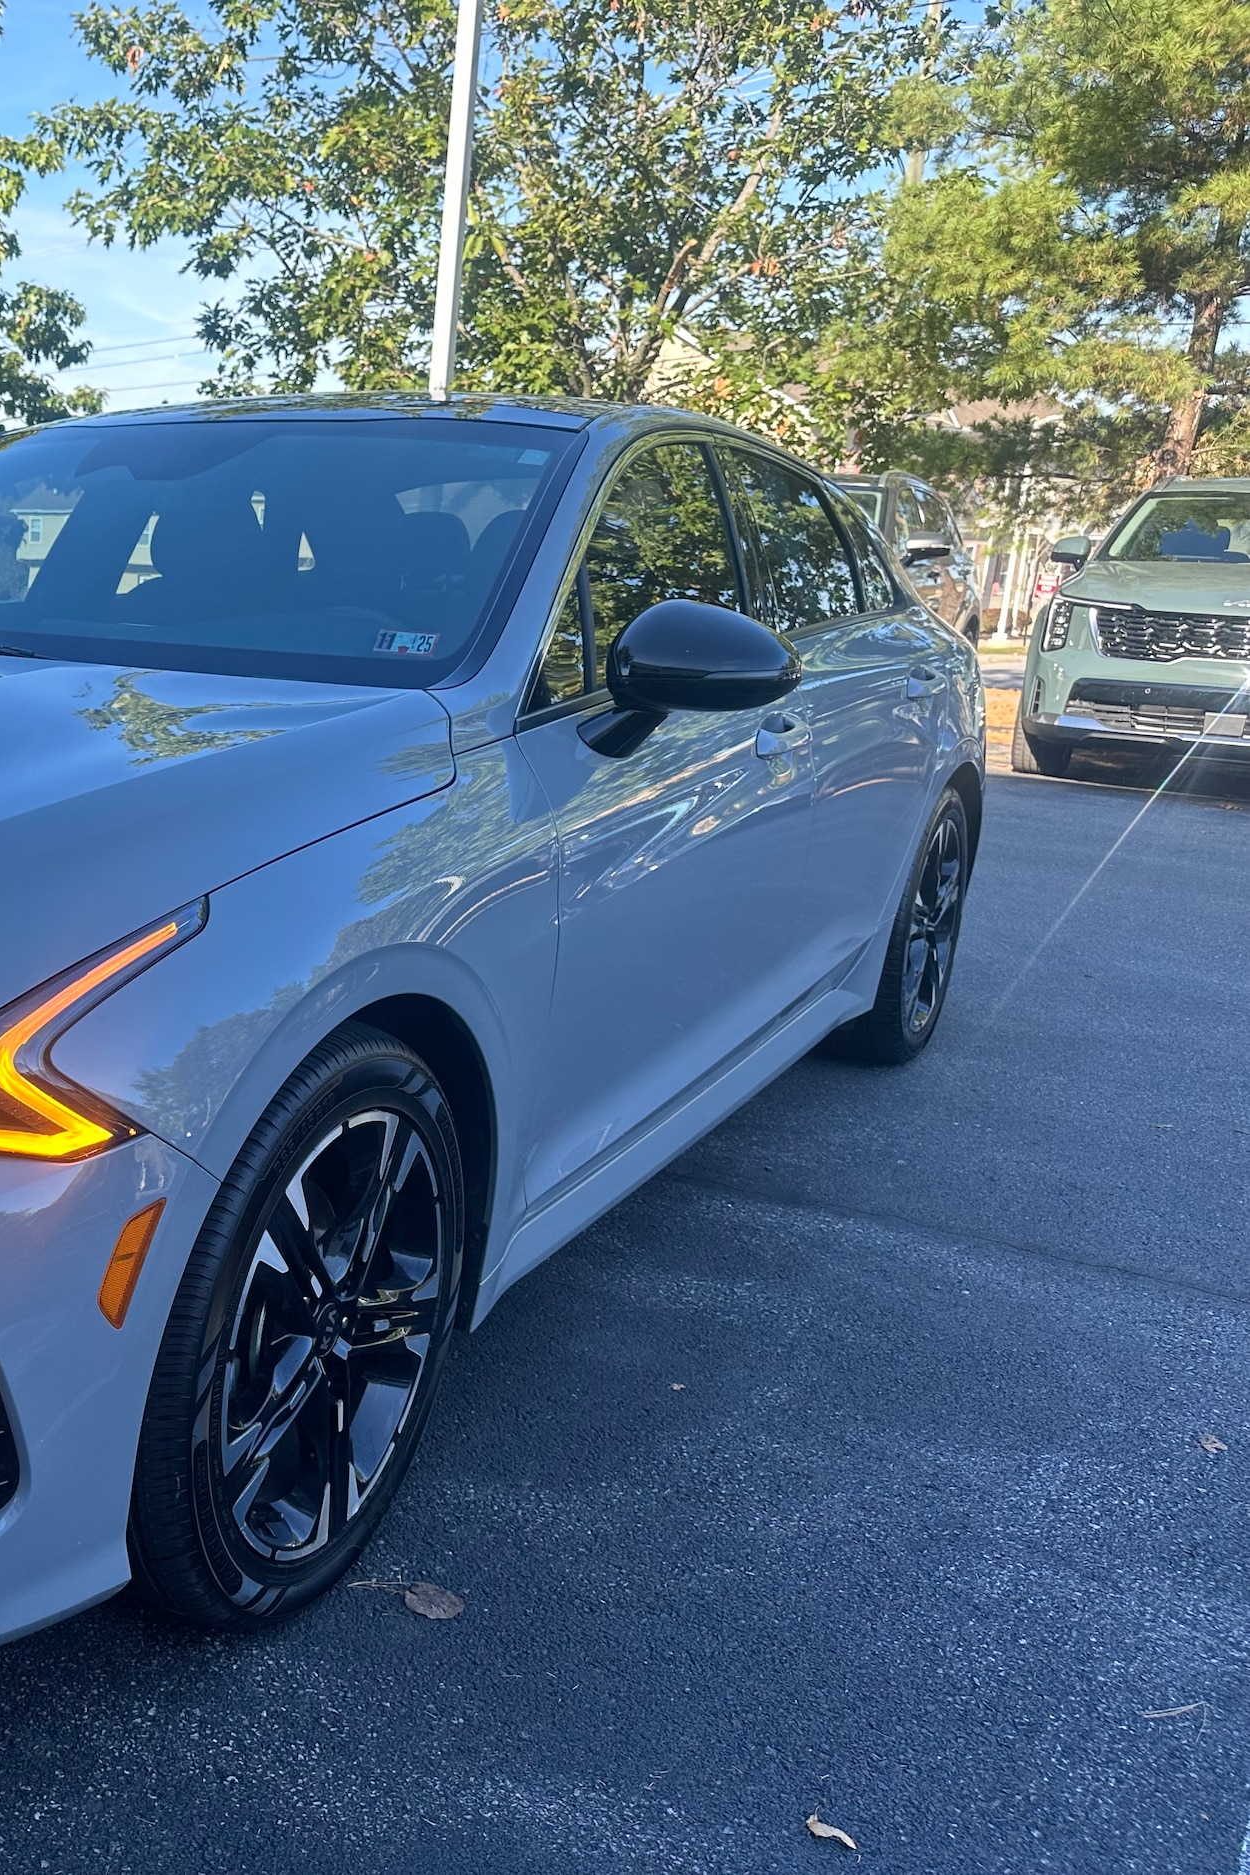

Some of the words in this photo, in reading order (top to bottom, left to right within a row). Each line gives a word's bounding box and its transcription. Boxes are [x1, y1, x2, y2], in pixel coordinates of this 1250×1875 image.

[378, 632, 397, 649] 11
[416, 636, 433, 653] 25
[320, 1309, 337, 1349] KIA
